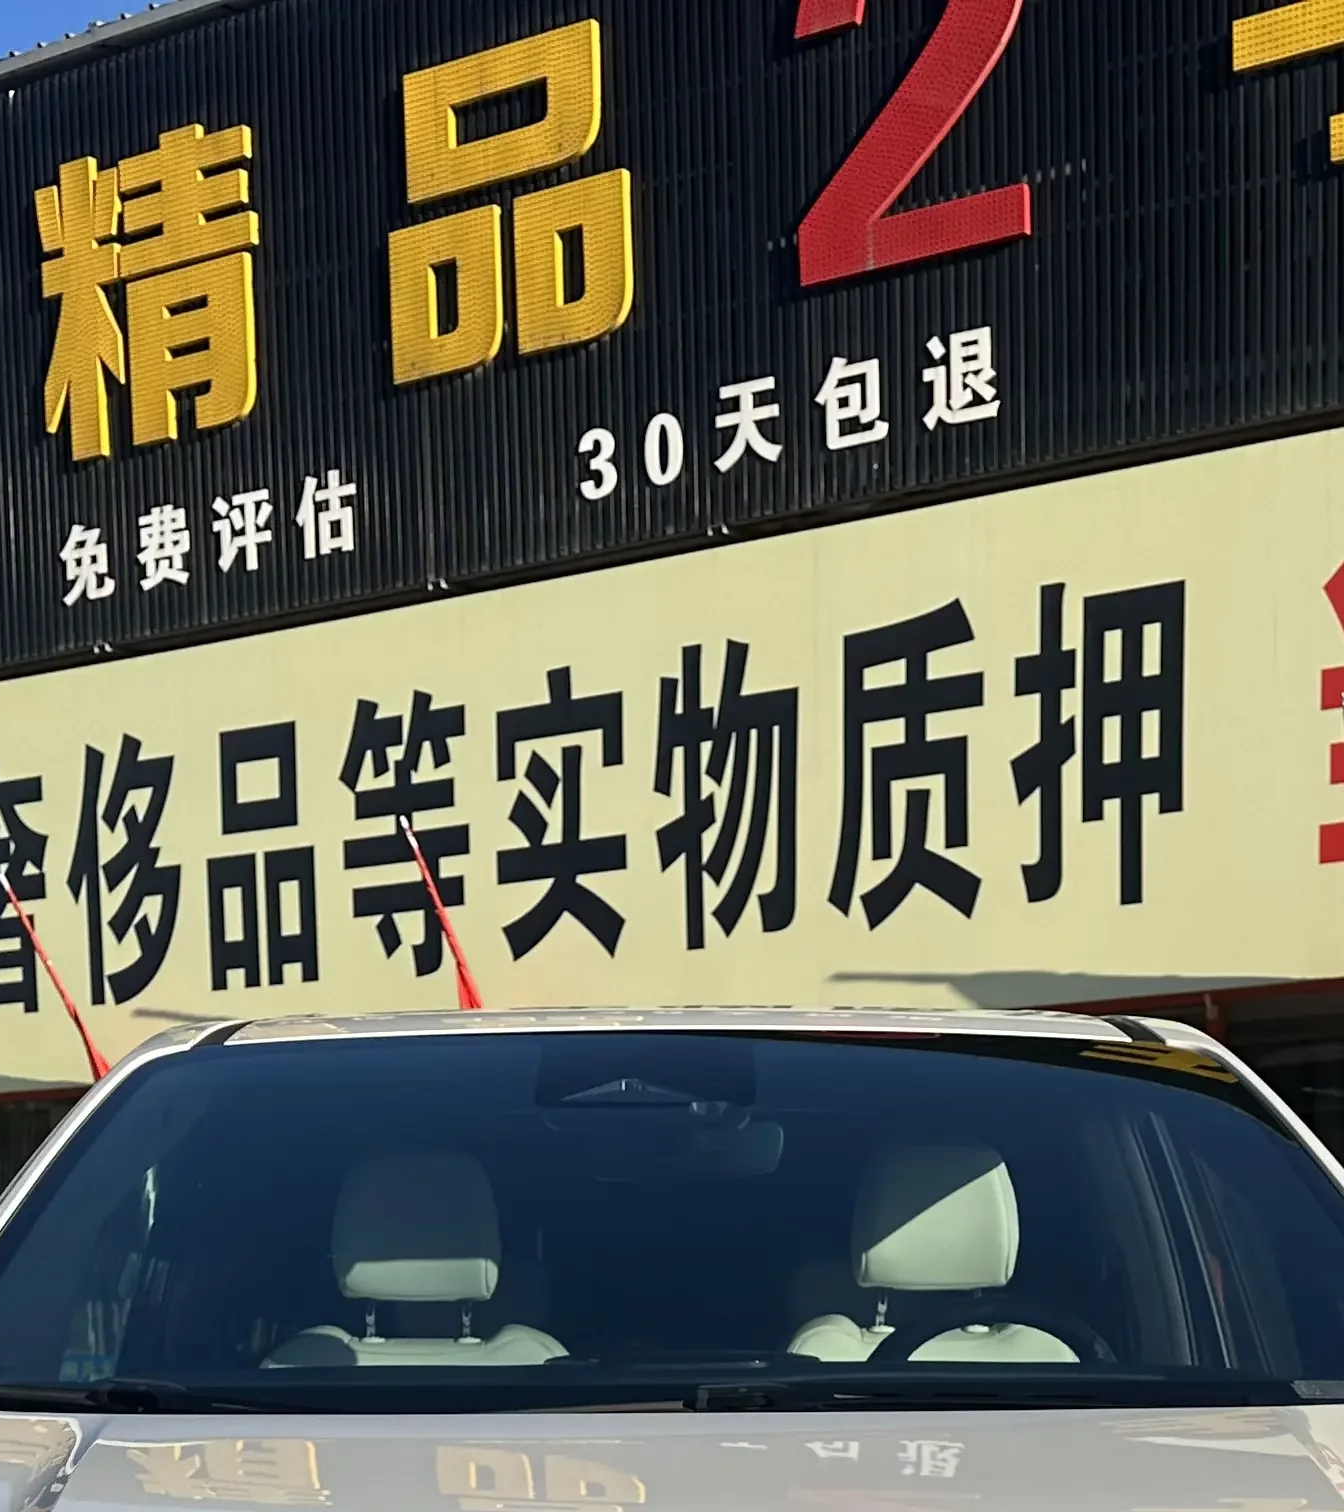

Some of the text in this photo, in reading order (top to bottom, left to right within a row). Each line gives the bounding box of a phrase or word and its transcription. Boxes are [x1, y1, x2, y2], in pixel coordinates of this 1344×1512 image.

[60, 469, 358, 607] 免费评估
[577, 326, 1001, 502] 30天包退
